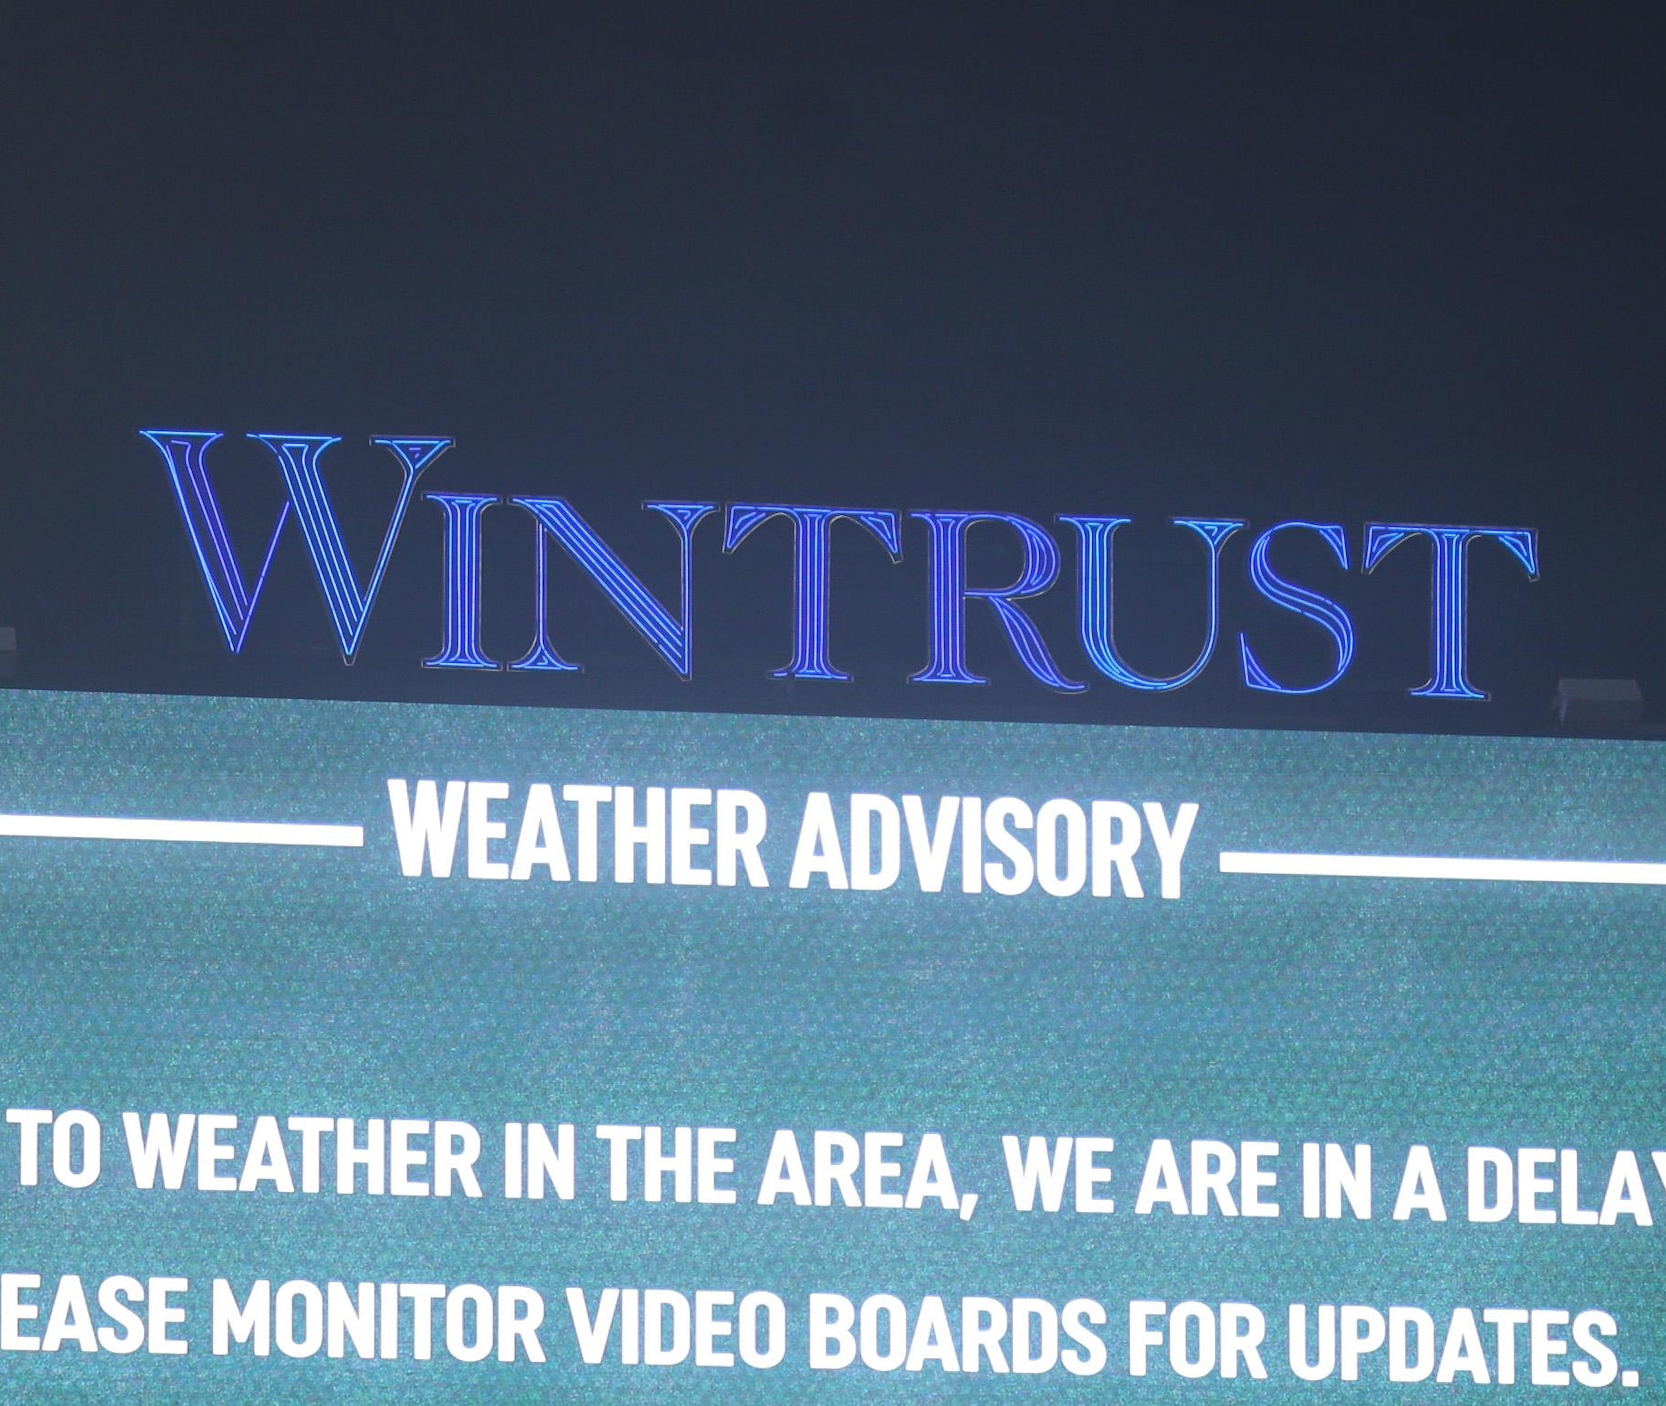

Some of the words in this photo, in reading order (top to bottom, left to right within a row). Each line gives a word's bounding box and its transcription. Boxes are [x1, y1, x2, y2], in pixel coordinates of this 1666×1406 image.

[138, 428, 1539, 704] WINTRUST
[387, 778, 770, 888] WEATHER
[789, 792, 1200, 899] ADVISORY
[6, 1108, 101, 1189] TO
[122, 1112, 483, 1198] WEATHER
[504, 1122, 575, 1200] IN
[596, 1124, 737, 1204] THE
[757, 1129, 979, 1221] AREA,
[1002, 1135, 1115, 1214] WE
[1134, 1139, 1280, 1218] ARE
[1303, 1142, 1372, 1220] IN
[1392, 1145, 1447, 1222] A
[212, 1278, 546, 1363] MONITOR
[565, 1287, 786, 1369] VIDEO
[809, 1293, 1107, 1376] BOARDS
[1129, 1300, 1268, 1379] FOR
[1288, 1303, 1639, 1388] UPDATES.
